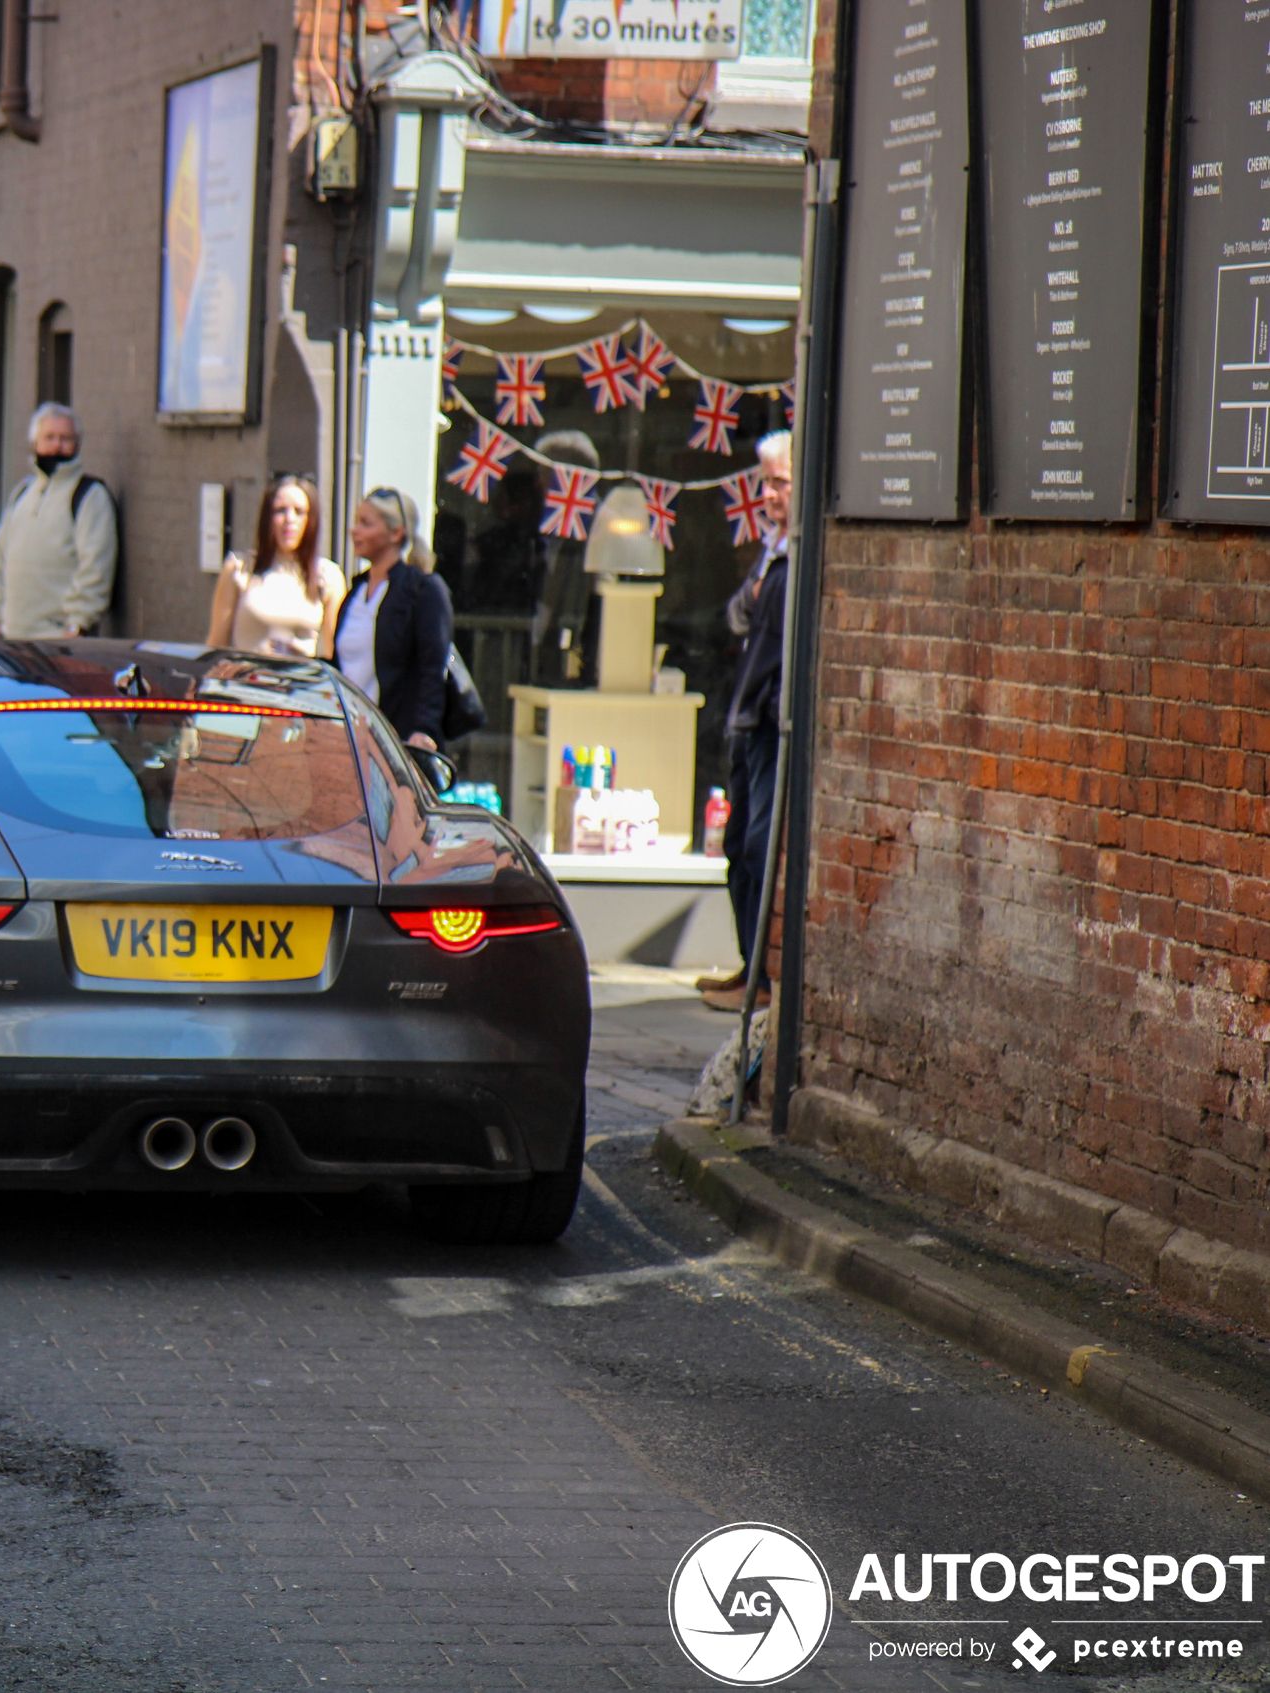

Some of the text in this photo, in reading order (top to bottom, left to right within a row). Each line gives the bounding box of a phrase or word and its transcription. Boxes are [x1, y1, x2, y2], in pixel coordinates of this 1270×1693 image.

[533, 16, 736, 44] to 30 minutes
[1022, 19, 1106, 50] THE VINTAGE WEDDING SHOP
[1050, 67, 1078, 86] NUTTERS
[1248, 99, 1261, 116] THE
[1054, 117, 1082, 135] OSBORNE
[1048, 168, 1080, 186] BERRY RED
[1192, 161, 1223, 179] HAT TRICK
[1047, 270, 1079, 286] WHITEHALL
[1052, 320, 1075, 335] FODDER
[1052, 370, 1073, 385] ROCKET
[1050, 420, 1075, 435] OUTBACK
[1042, 470, 1055, 484] JOHN
[166, 830, 220, 840] LISTERS
[101, 917, 295, 960] VK19 KNX
